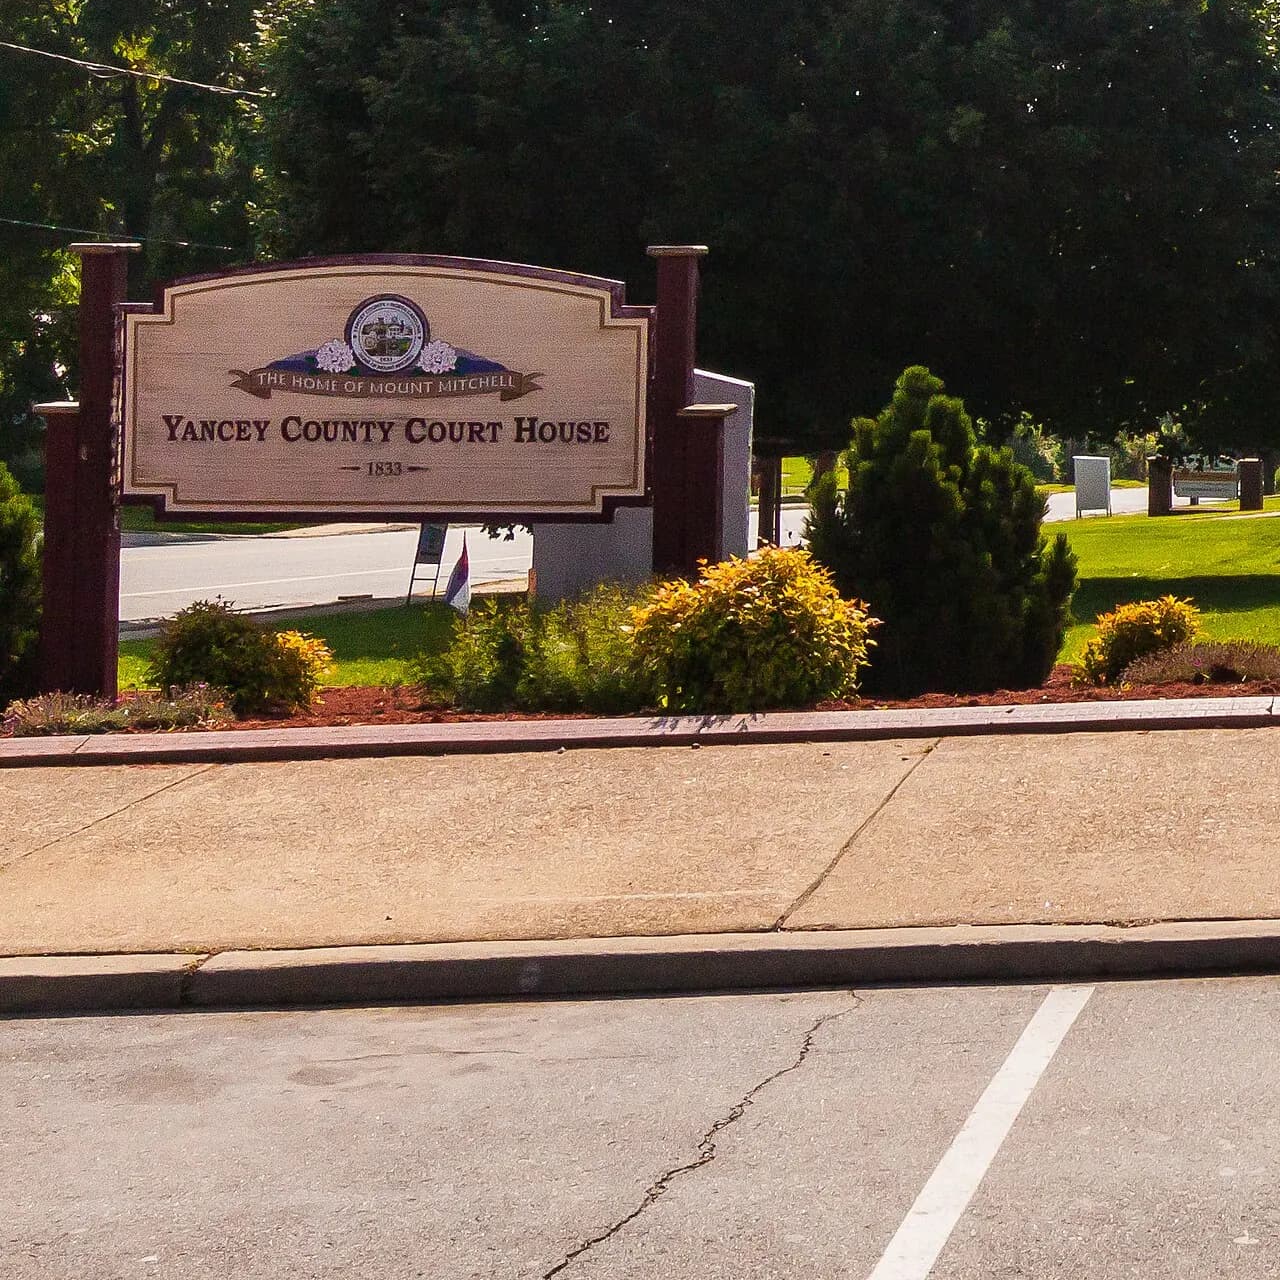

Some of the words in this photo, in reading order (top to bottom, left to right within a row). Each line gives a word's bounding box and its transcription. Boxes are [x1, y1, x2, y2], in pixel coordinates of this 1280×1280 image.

[257, 372, 285, 385] THE
[292, 377, 337, 393] HOME
[344, 380, 363, 393] OF
[374, 381, 431, 394] MOUNT
[438, 375, 516, 393] MITCHELL
[367, 462, 401, 477] 1833
